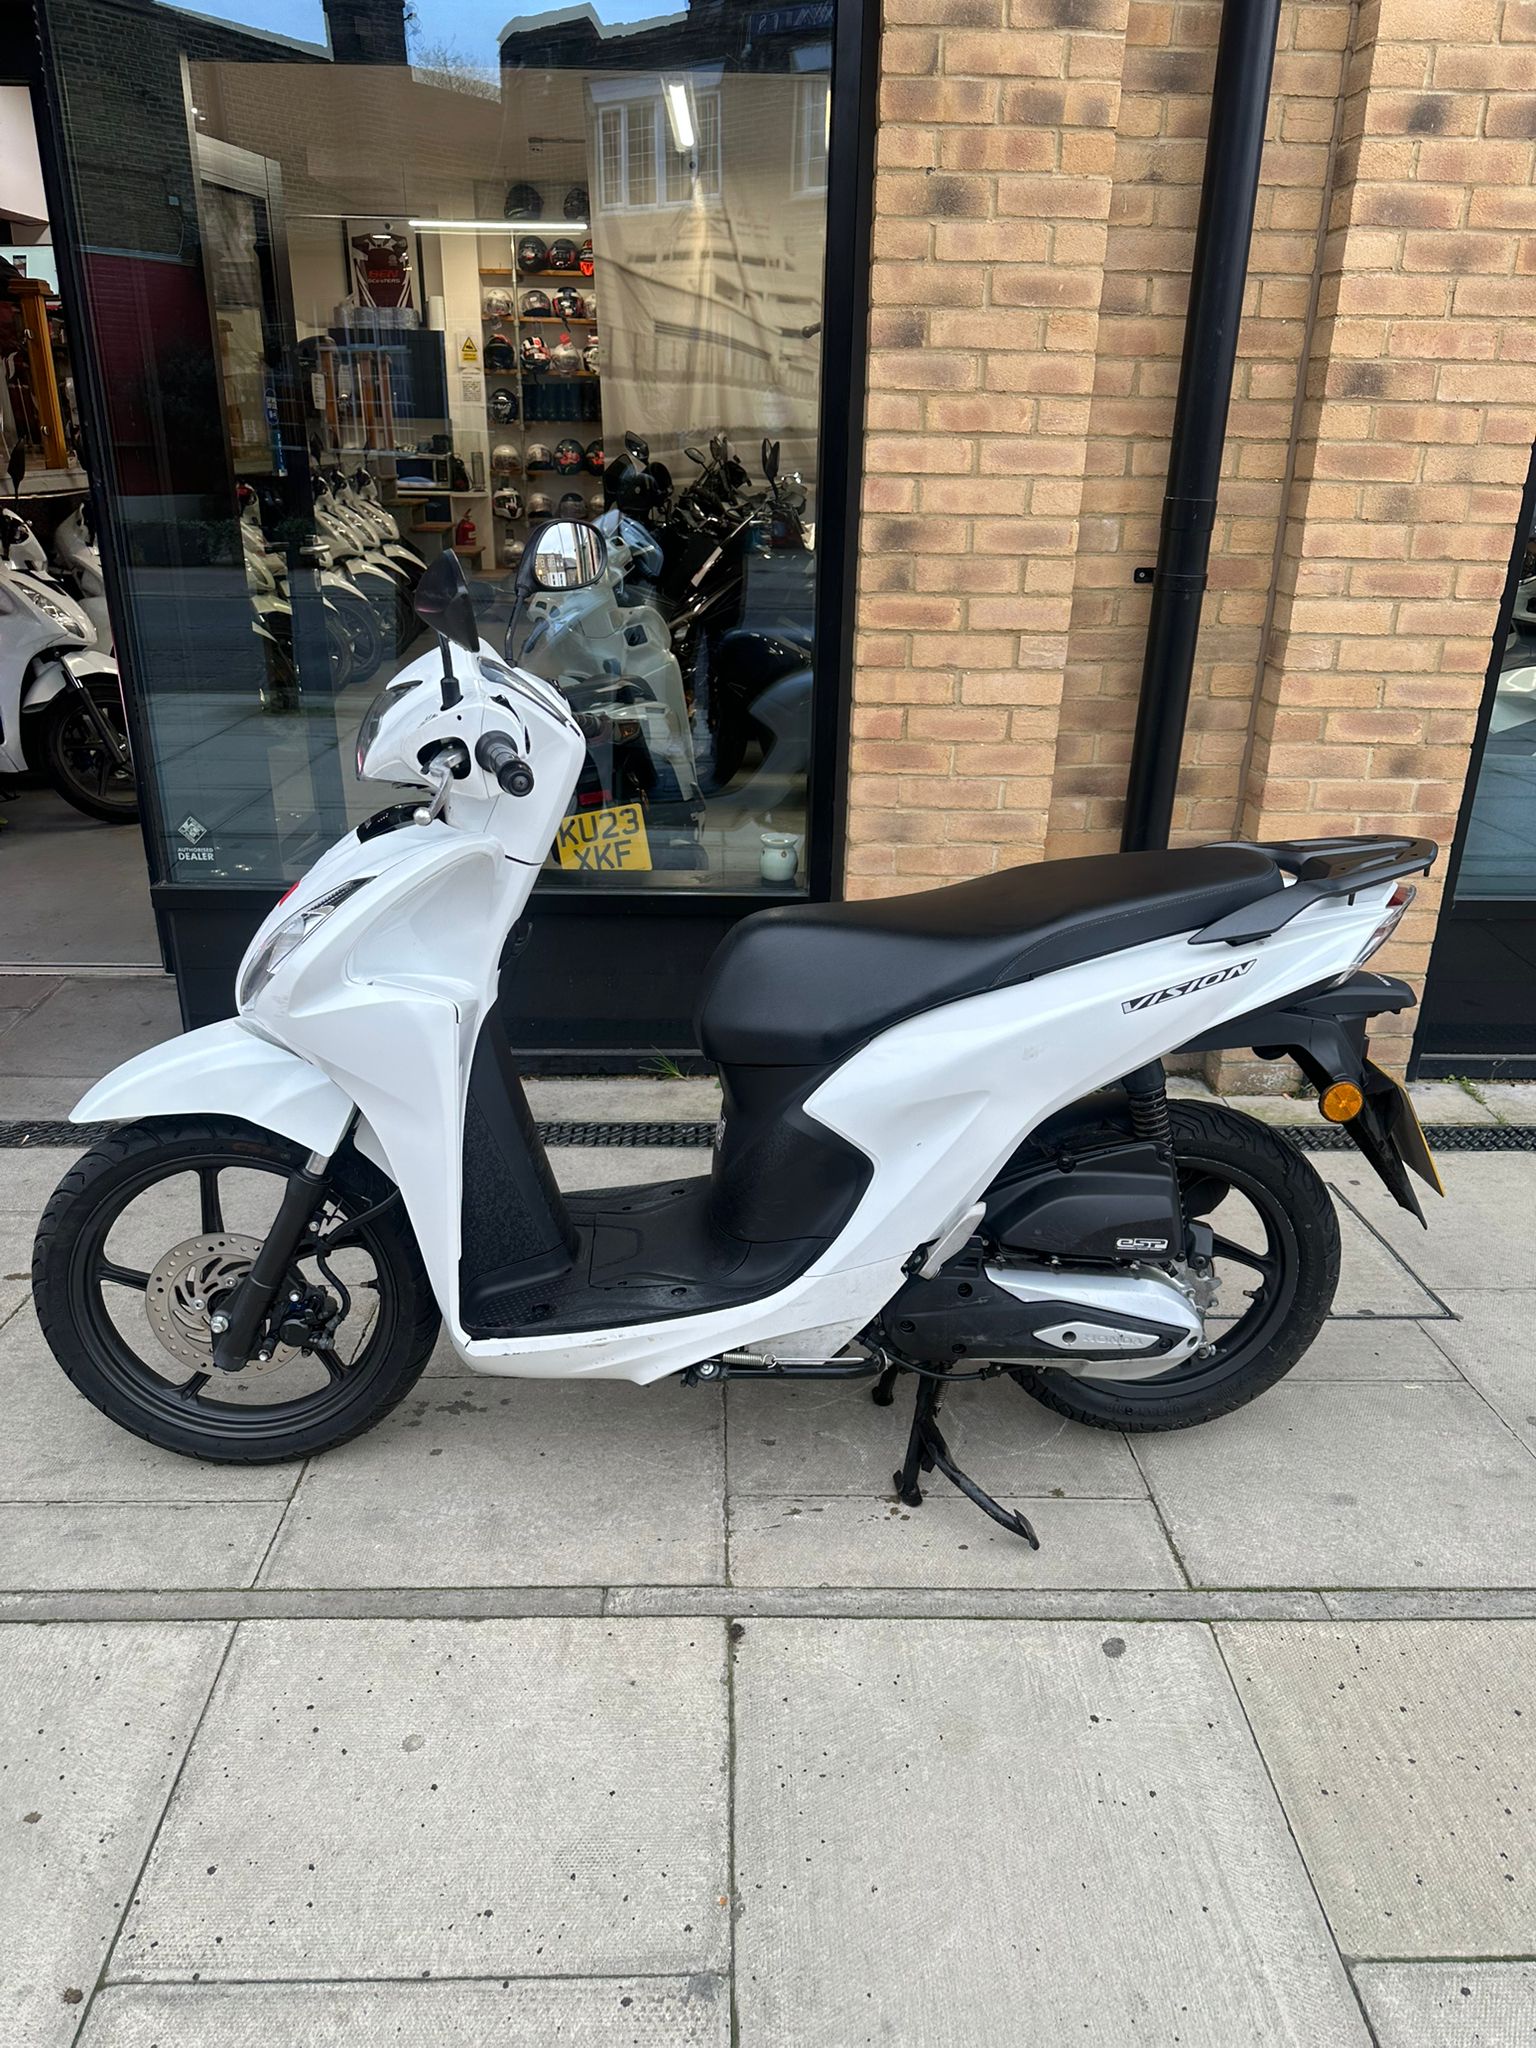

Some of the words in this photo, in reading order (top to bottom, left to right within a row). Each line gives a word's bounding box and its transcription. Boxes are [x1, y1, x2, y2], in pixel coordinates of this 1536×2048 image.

[559, 808, 640, 847] KU23
[177, 852, 215, 861] DEALER
[573, 839, 632, 870] XKF
[1121, 958, 1258, 1015] VISION
[1082, 1332, 1144, 1346] HONDA
